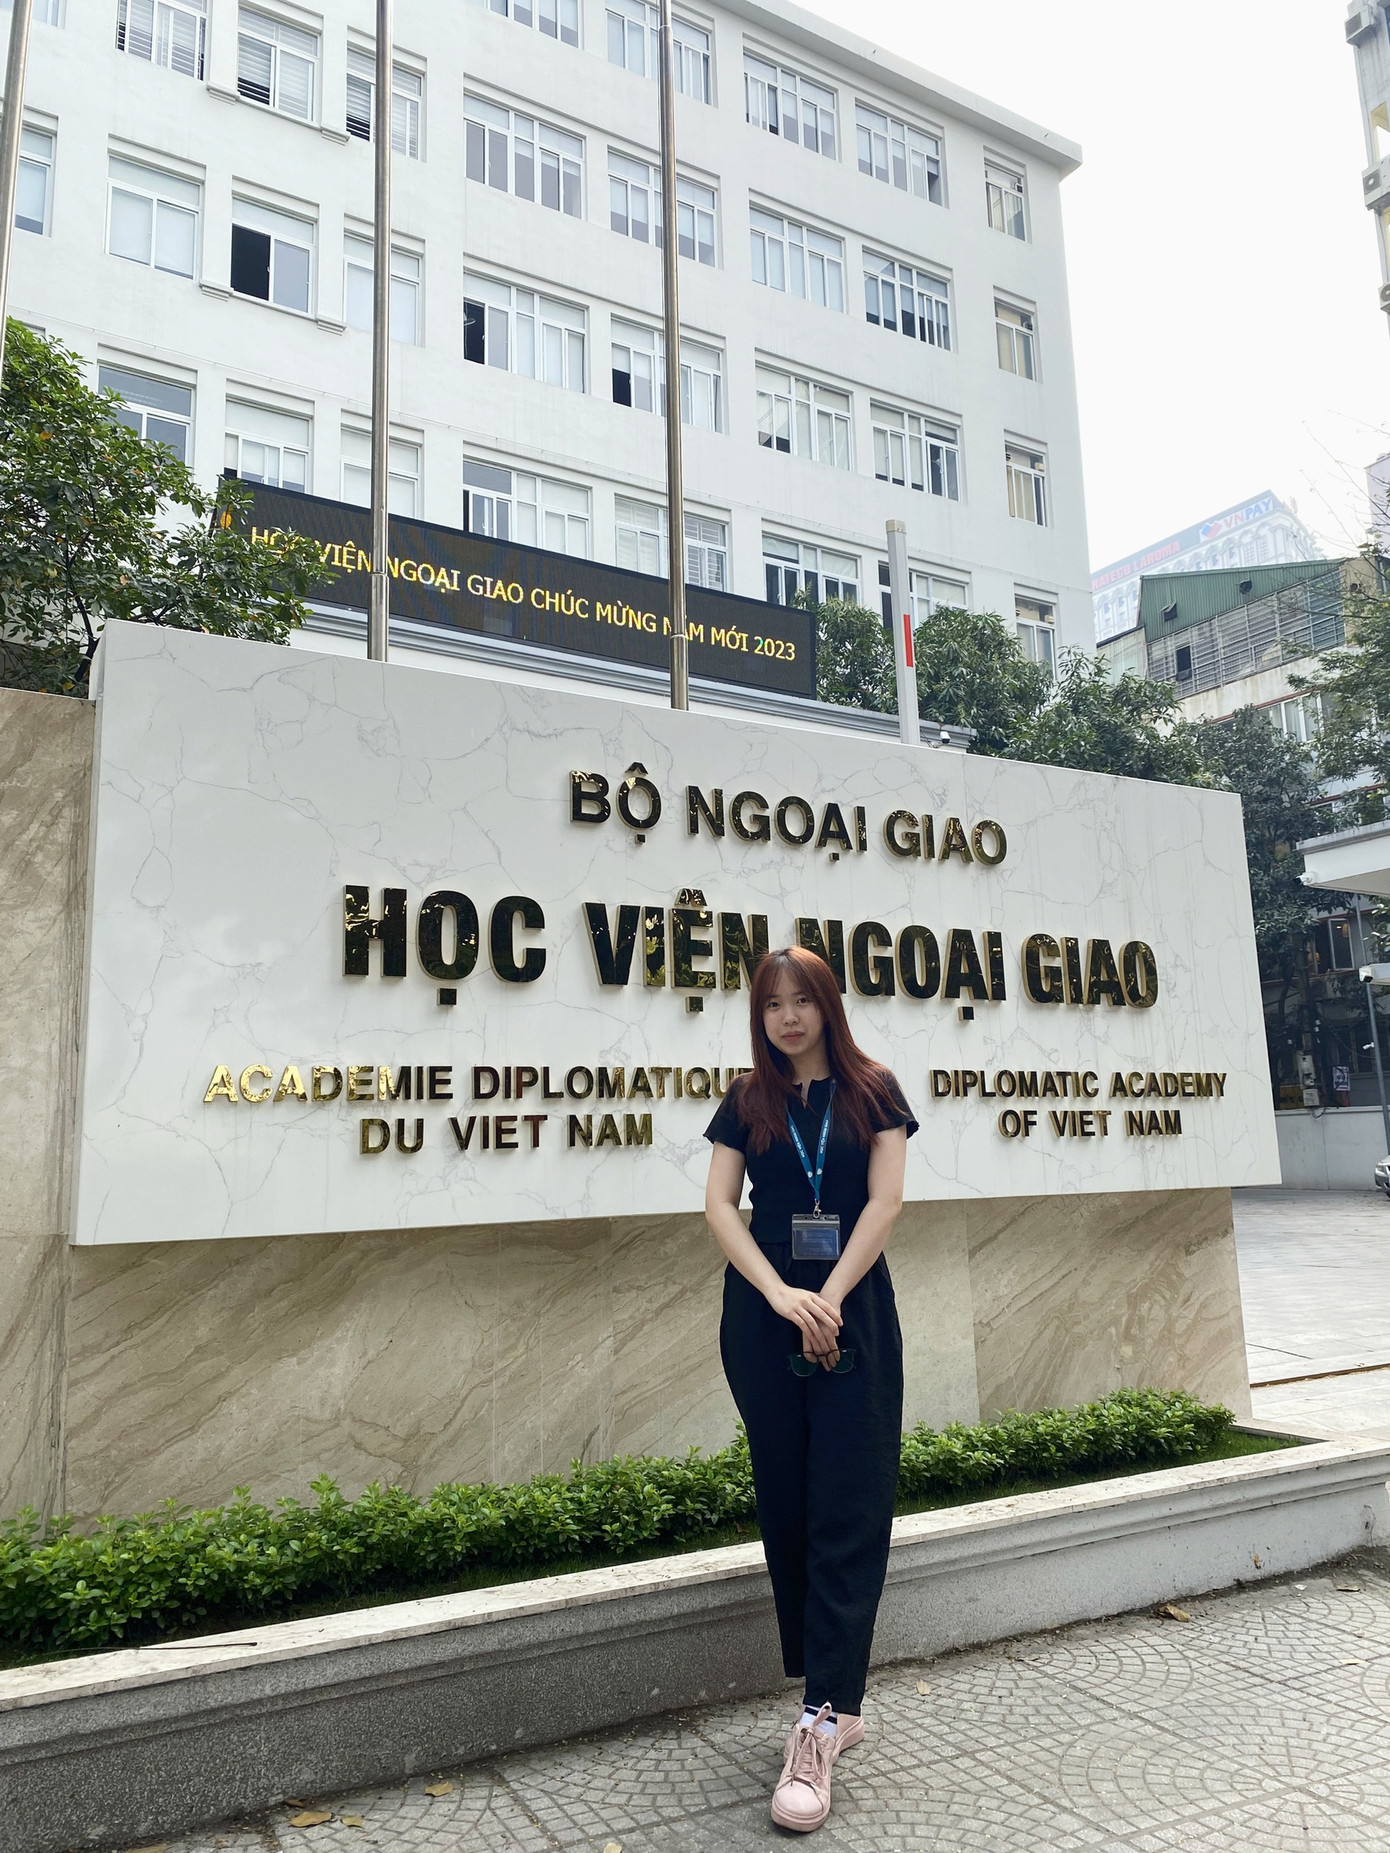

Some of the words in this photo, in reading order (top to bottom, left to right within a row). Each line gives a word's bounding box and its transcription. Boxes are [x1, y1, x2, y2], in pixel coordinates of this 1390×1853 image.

[1223, 498, 1271, 528] VNPAY
[314, 540, 372, 573] VIỆN
[386, 555, 460, 593] NGOẠI
[467, 574, 524, 604] GIAO
[531, 589, 589, 619] CHÚC
[596, 600, 657, 633] MỪNG
[663, 615, 704, 643] NM
[711, 625, 749, 652] MỚI
[754, 636, 796, 661] 2023
[569, 762, 662, 844] BỘ
[685, 784, 867, 861] NGOẠI
[884, 809, 1008, 865] GIAO
[342, 884, 547, 1006] HỌC
[582, 888, 769, 1013] VIỆN
[795, 917, 1007, 1021] NGOẠI
[1022, 933, 1158, 1009] GIAO
[203, 1064, 453, 1103] ACADEMIE
[929, 1069, 1099, 1098] DIPLOMATIC
[1108, 1071, 1227, 1098] ACADEMY
[359, 1118, 425, 1154] DU
[448, 1114, 548, 1151] VIET
[566, 1113, 653, 1148] NAM
[998, 1109, 1038, 1138] OF
[1048, 1109, 1112, 1137] VIET
[1124, 1109, 1183, 1137] NAM
